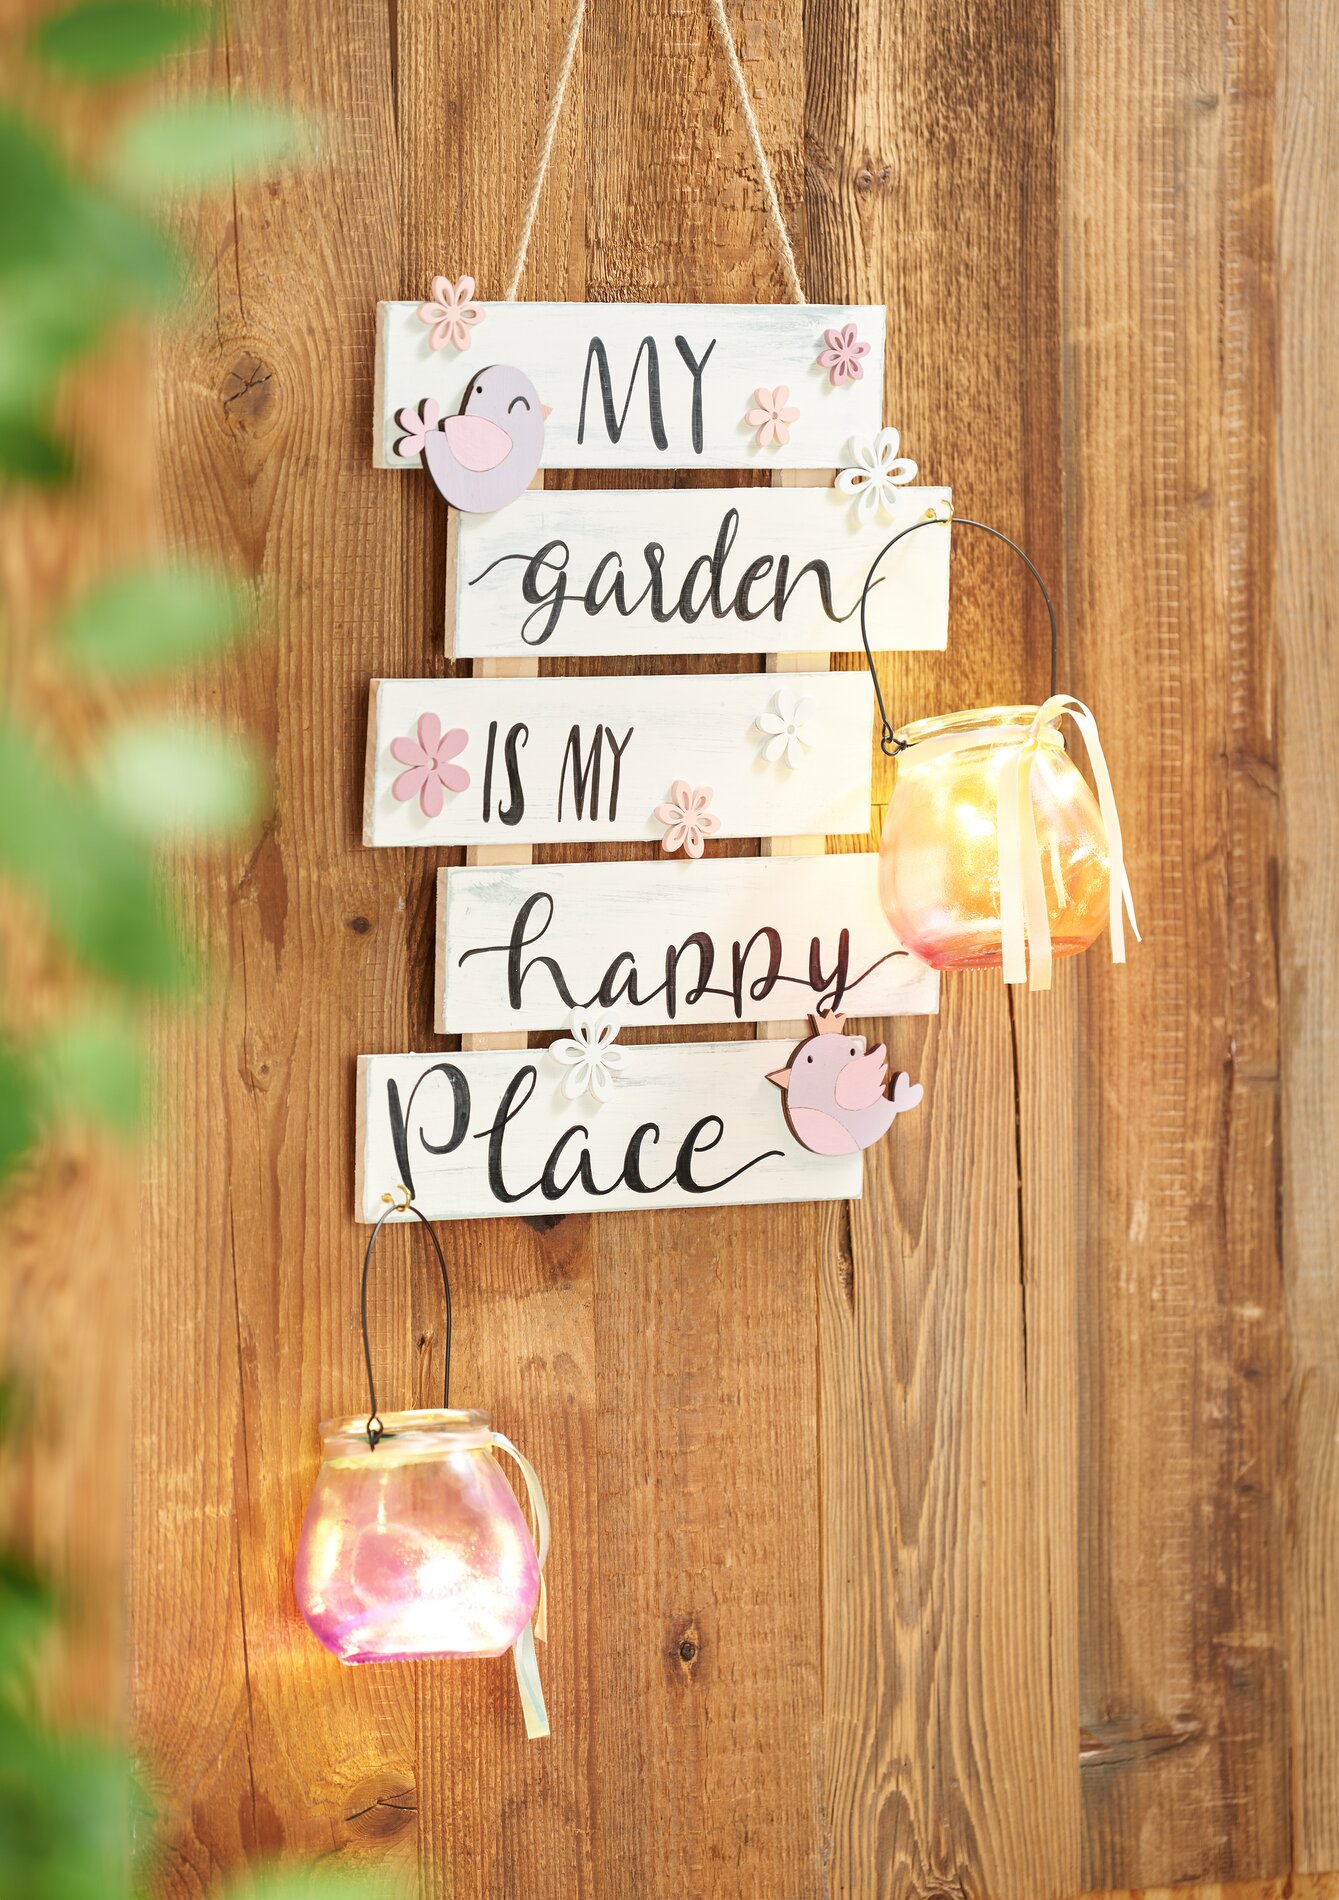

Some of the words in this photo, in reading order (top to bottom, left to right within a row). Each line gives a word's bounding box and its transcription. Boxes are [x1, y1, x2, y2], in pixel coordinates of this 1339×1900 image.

[577, 335, 717, 454] MY
[468, 507, 886, 645] garden
[482, 720, 529, 826] IS
[558, 723, 634, 823] MY
[459, 891, 909, 1019] happy
